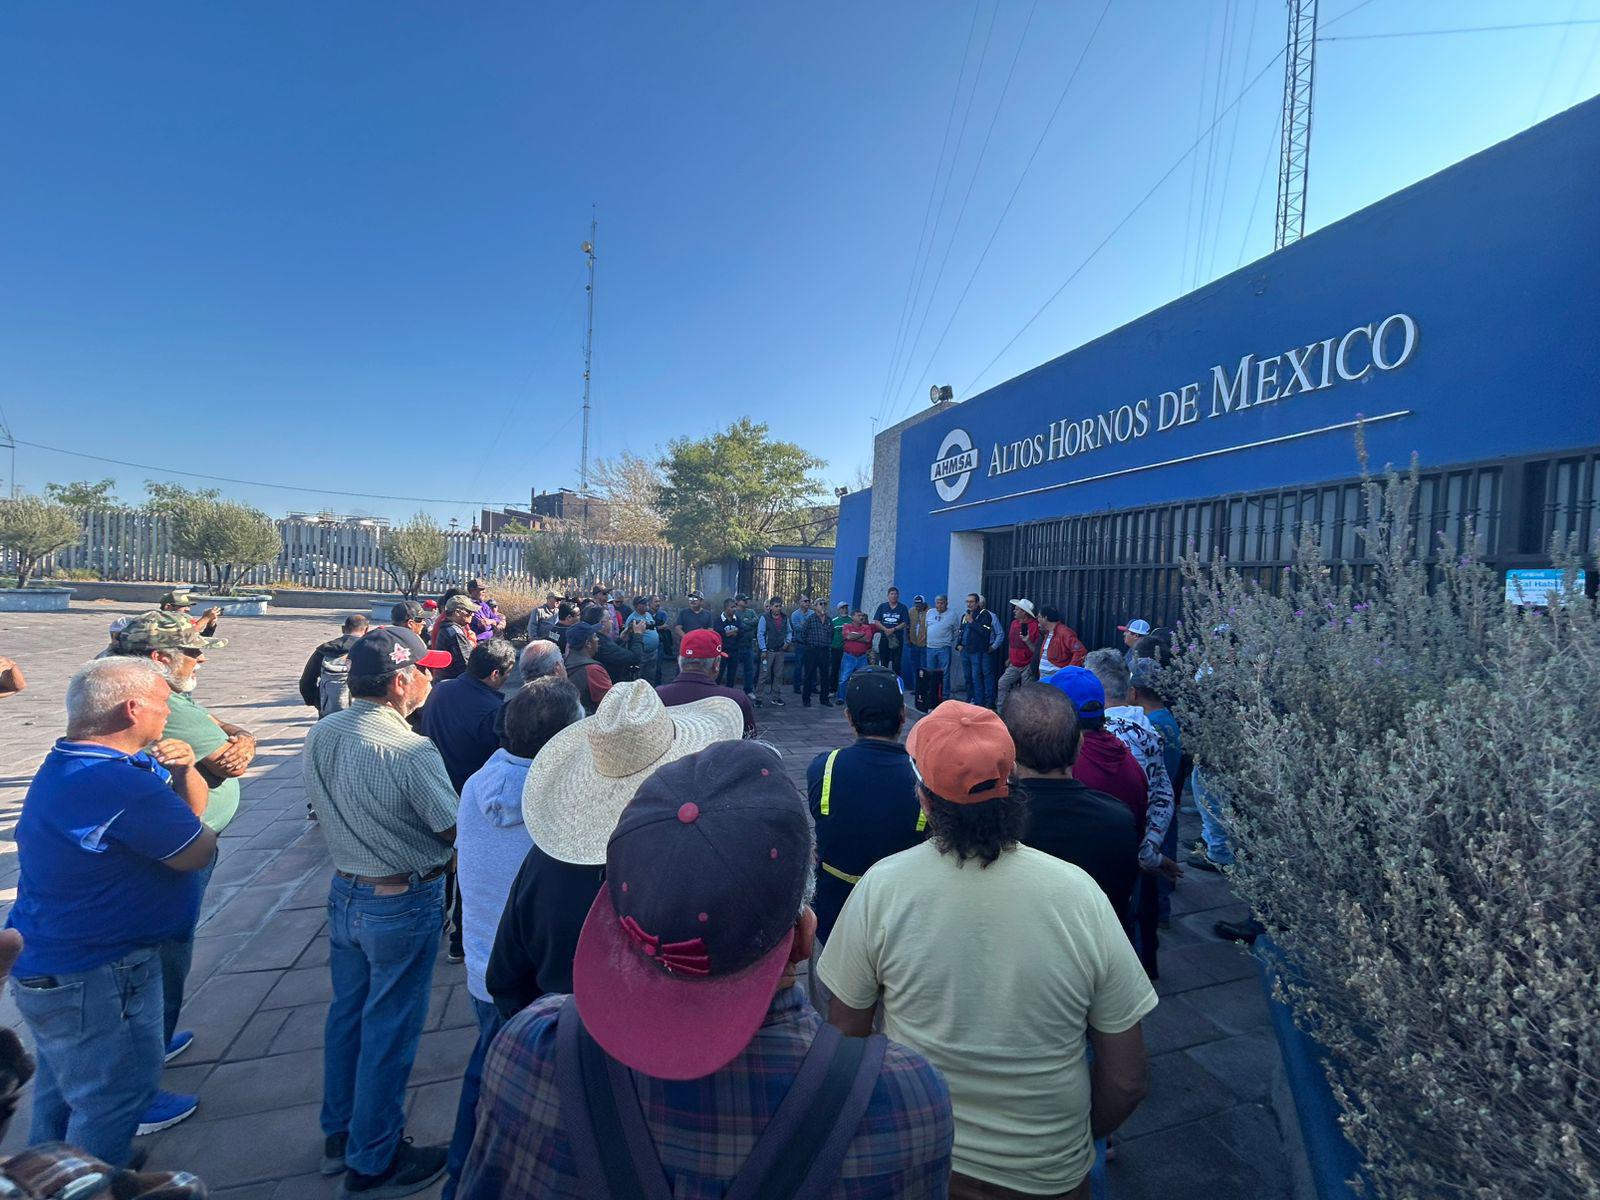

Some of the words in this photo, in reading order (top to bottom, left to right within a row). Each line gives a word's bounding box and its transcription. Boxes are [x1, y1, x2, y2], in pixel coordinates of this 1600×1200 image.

[987, 434, 1044, 477] ALTOS
[1047, 398, 1149, 461] HORNOS
[1157, 383, 1199, 431] DE
[1207, 313, 1415, 418] MEXICO
[934, 454, 973, 478] AHMSA
